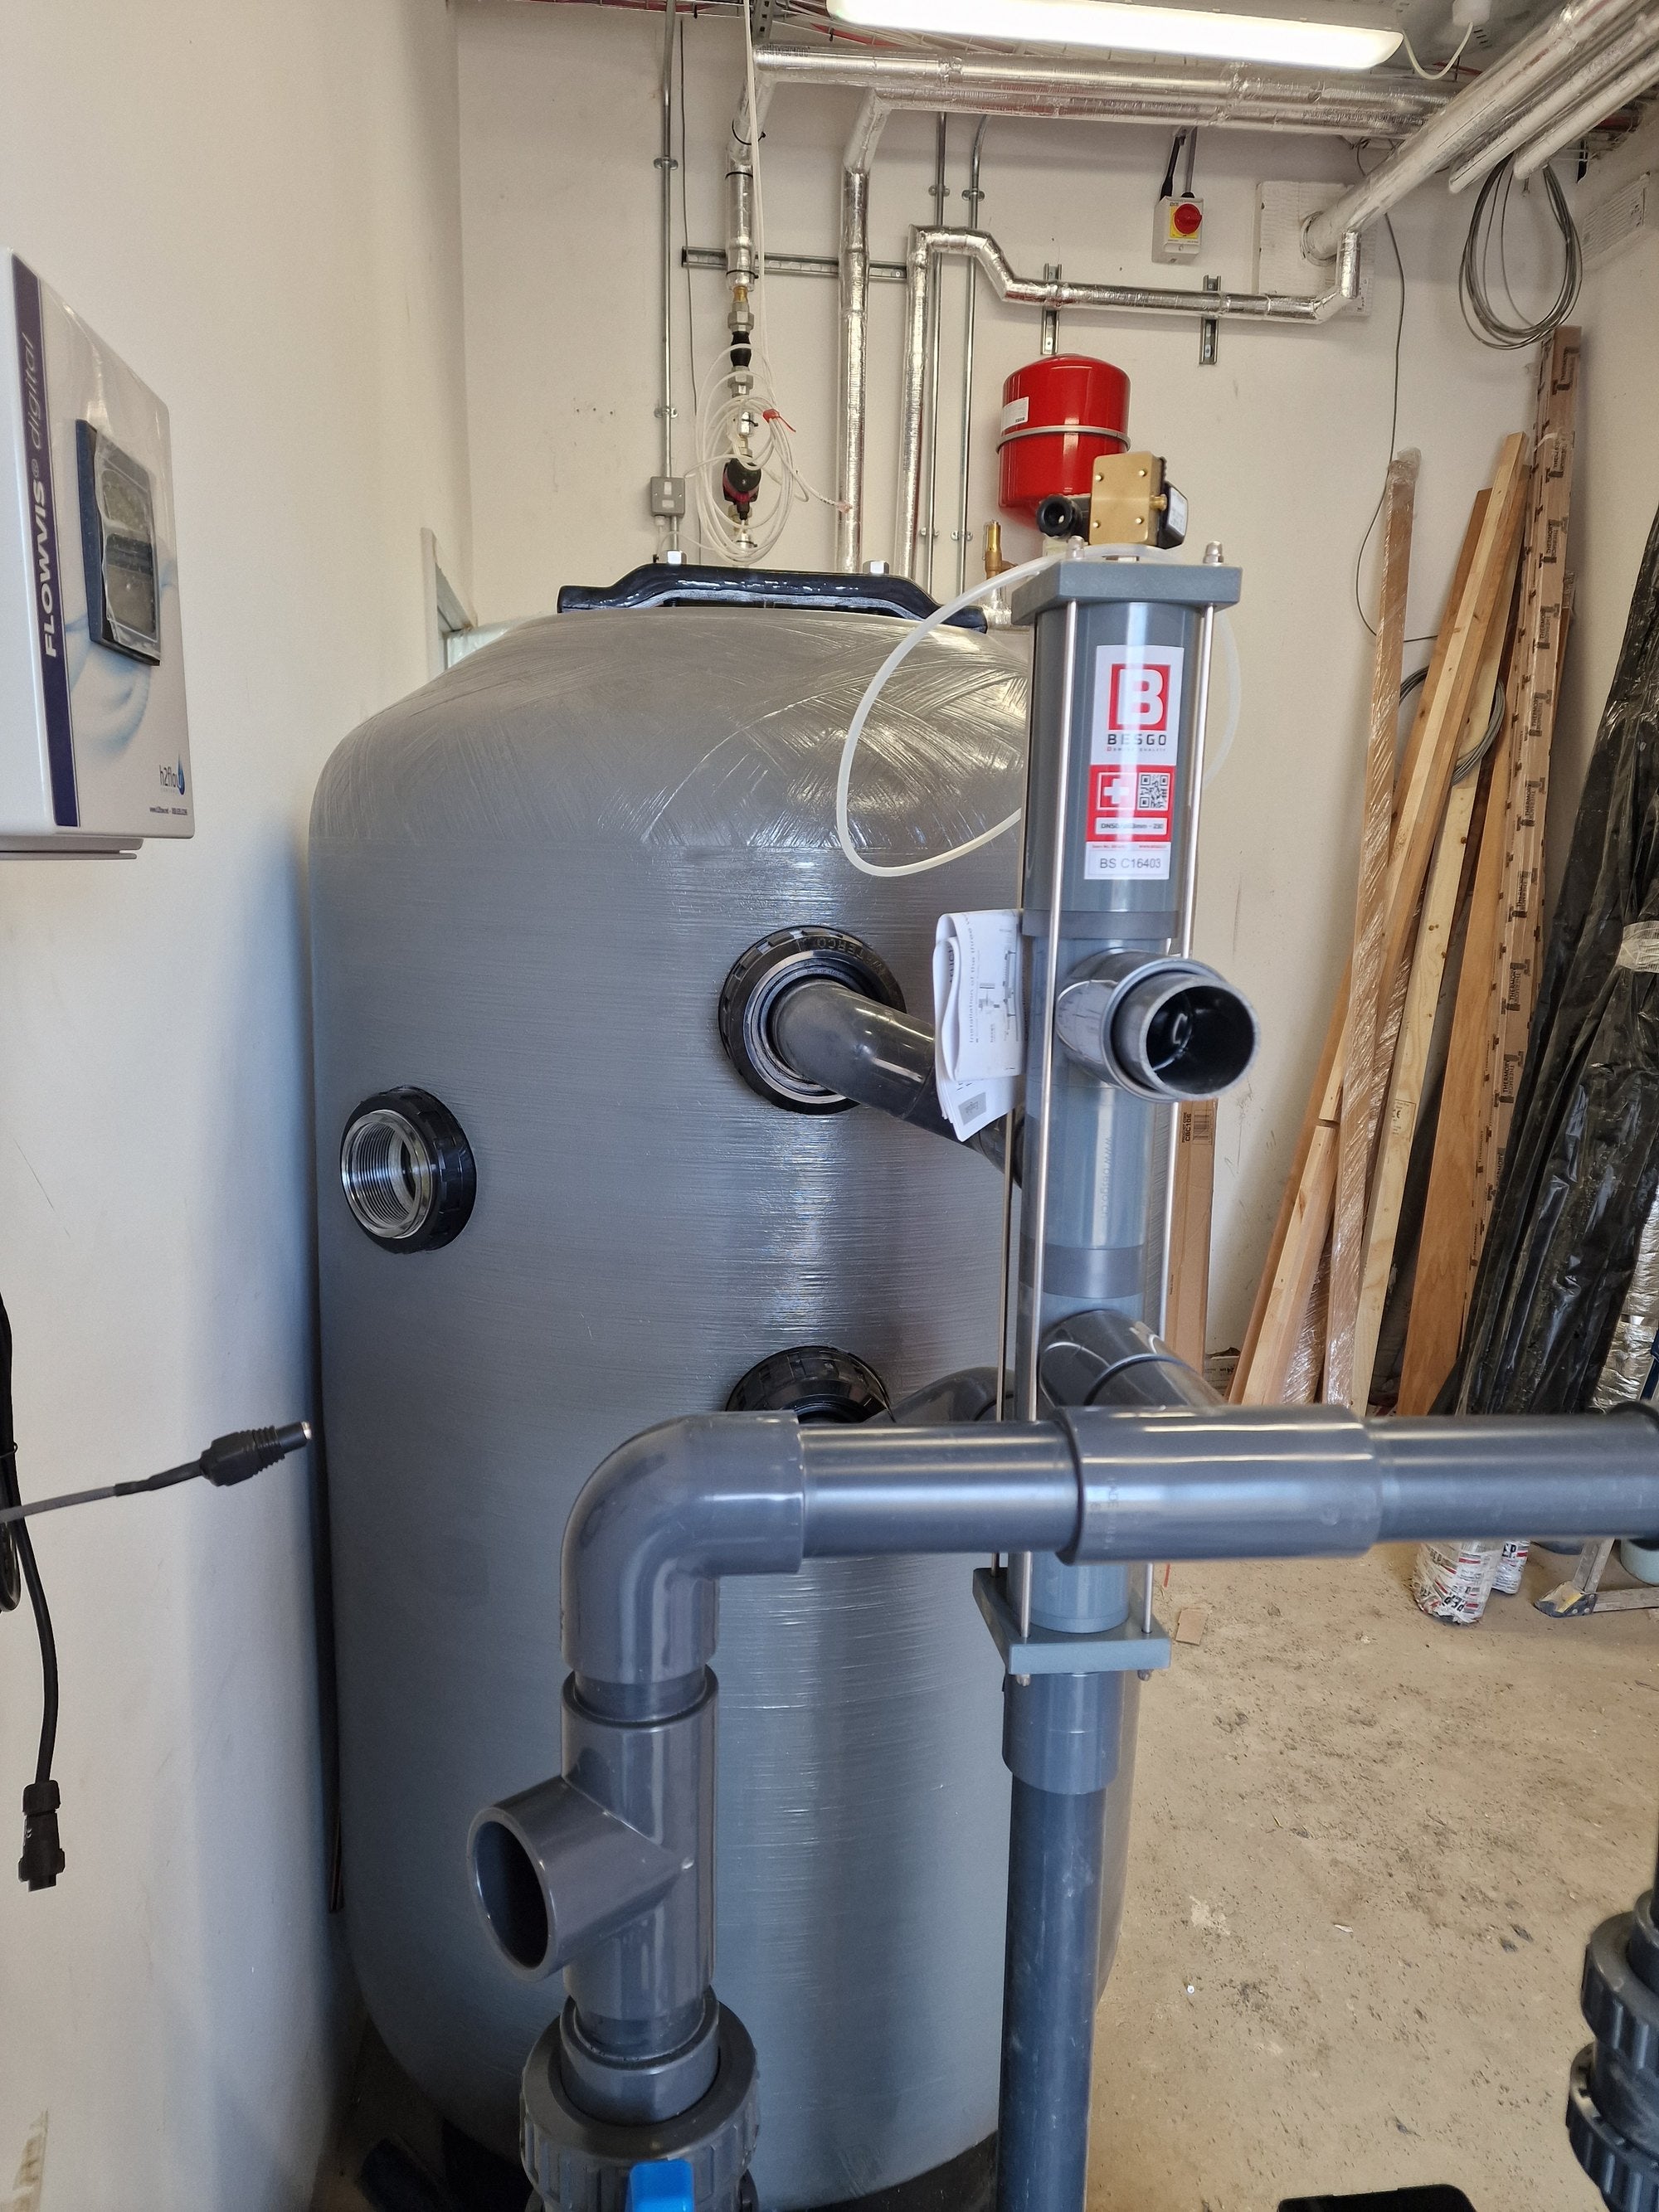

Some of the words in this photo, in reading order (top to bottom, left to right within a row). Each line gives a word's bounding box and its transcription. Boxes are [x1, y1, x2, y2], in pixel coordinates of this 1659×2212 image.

[22, 332, 41, 450] digital
[1117, 668, 1164, 727] B
[1107, 733, 1166, 746] BESGO
[1100, 858, 1117, 868] BS
[1121, 858, 1161, 868] C16403
[1502, 1059, 1511, 1093] THERMORY
